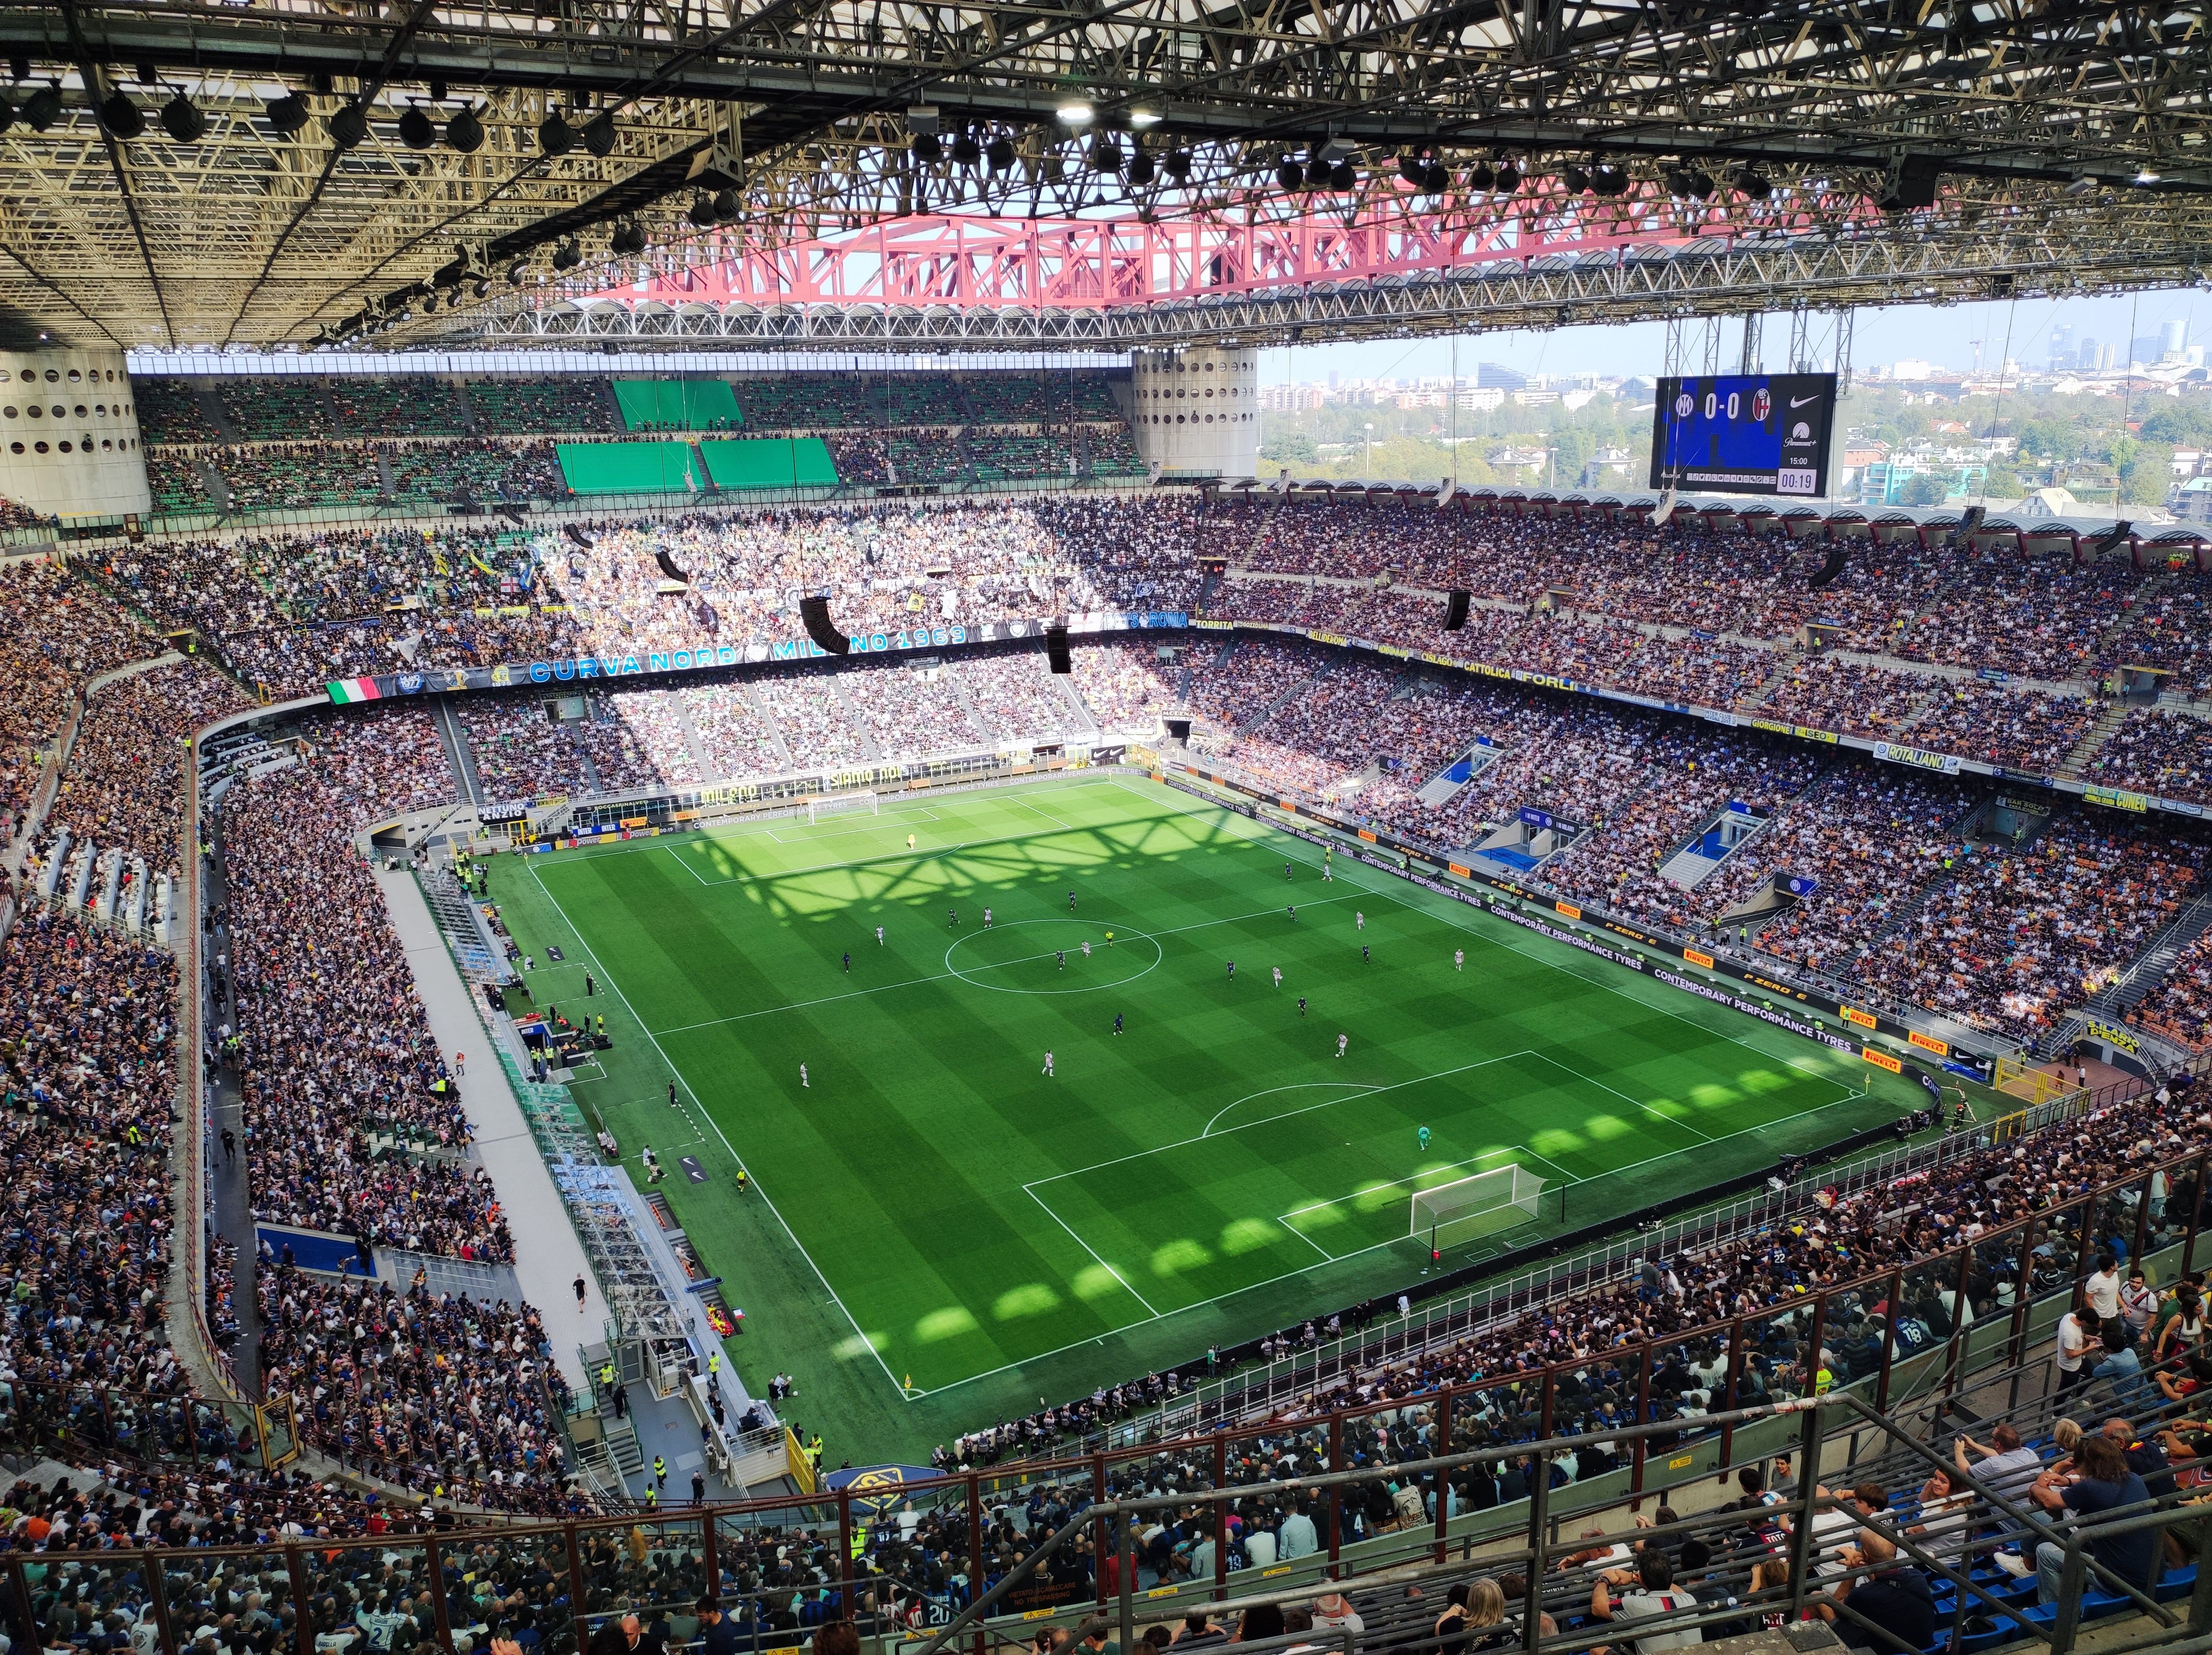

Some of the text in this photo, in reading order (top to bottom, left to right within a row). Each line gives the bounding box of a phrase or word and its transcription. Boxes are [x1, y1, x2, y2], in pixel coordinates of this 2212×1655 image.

[1783, 437, 1817, 447] Paramount+
[1782, 474, 1811, 488] 00:19
[1149, 612, 1188, 627] ROMA
[1196, 620, 1233, 630] TORRITA
[1242, 621, 1269, 629] GOZZOLINA
[529, 625, 967, 683] CURVA NORD MILNO 1969
[1421, 653, 1453, 666] CISLAGO
[1464, 661, 1511, 679] CATTOLICA
[400, 679, 420, 687] 1977
[1644, 697, 1654, 705] INTER
[1654, 699, 1665, 708] CLUB
[1752, 719, 1790, 735] GIORGIONE
[1805, 729, 1826, 740] ISEO
[1888, 745, 1945, 769] ROTALIANO
[830, 770, 874, 787] SIAMO
[880, 766, 900, 780] NOI
[1010, 767, 1142, 785] CONTEMPORARY PERFORMANCE TYRES
[859, 791, 920, 806] CONTEMPORARY
[922, 785, 975, 797] PERFORMANCE
[1167, 779, 1249, 816] CONTEMPORARY PERFORMANCE TYRES
[2007, 798, 2024, 807] BAR
[2116, 793, 2147, 812] CUNEO
[477, 803, 524, 815] NETTUNO
[482, 810, 522, 821] ANZIO
[694, 801, 848, 829] CONTEMPORARY PERFORMANCE TYRES
[602, 824, 616, 832] INTER
[1316, 816, 1335, 826] ZERO
[1256, 814, 1353, 857] CONTEMPORARY PERFORMANCE TYRES
[1359, 830, 1375, 842] PIRELLI
[1401, 846, 1421, 858] ZERO
[1450, 864, 1469, 878] PIRELLI
[1361, 855, 1481, 907] CONTEMPORARY PERFORMANCE TYRES
[1498, 881, 1523, 896] ZEO
[1557, 903, 1579, 918] PIRELLI
[1491, 906, 1642, 971] CONTEMPORARY PERFORMANCE TYRES
[1614, 925, 1644, 940] ZERO
[1686, 950, 1711, 966] PIRELLI
[1754, 976, 1792, 994] ZERO
[1654, 969, 1851, 1052] CONTEMPORARY PERFORMANCE TYRES
[2087, 1019, 2140, 1048] S.ILARIO
[2090, 1027, 2135, 1053] D'ENZA
[1912, 1034, 1944, 1052] PIRELLI
[1866, 1051, 1897, 1070] PIRELLI
[1774, 1254, 1785, 1264] 22
[1478, 1391, 1489, 1406] 10
[1354, 1513, 1364, 1533] 4
[1227, 1554, 1242, 1572] 19
[1008, 1582, 1076, 1599] VIETATO SCAVALCARE
[1026, 1591, 1071, 1604] TRESPASSING
[909, 1610, 923, 1628] 10
[929, 1604, 949, 1624] 20
[370, 1627, 382, 1645] 2
